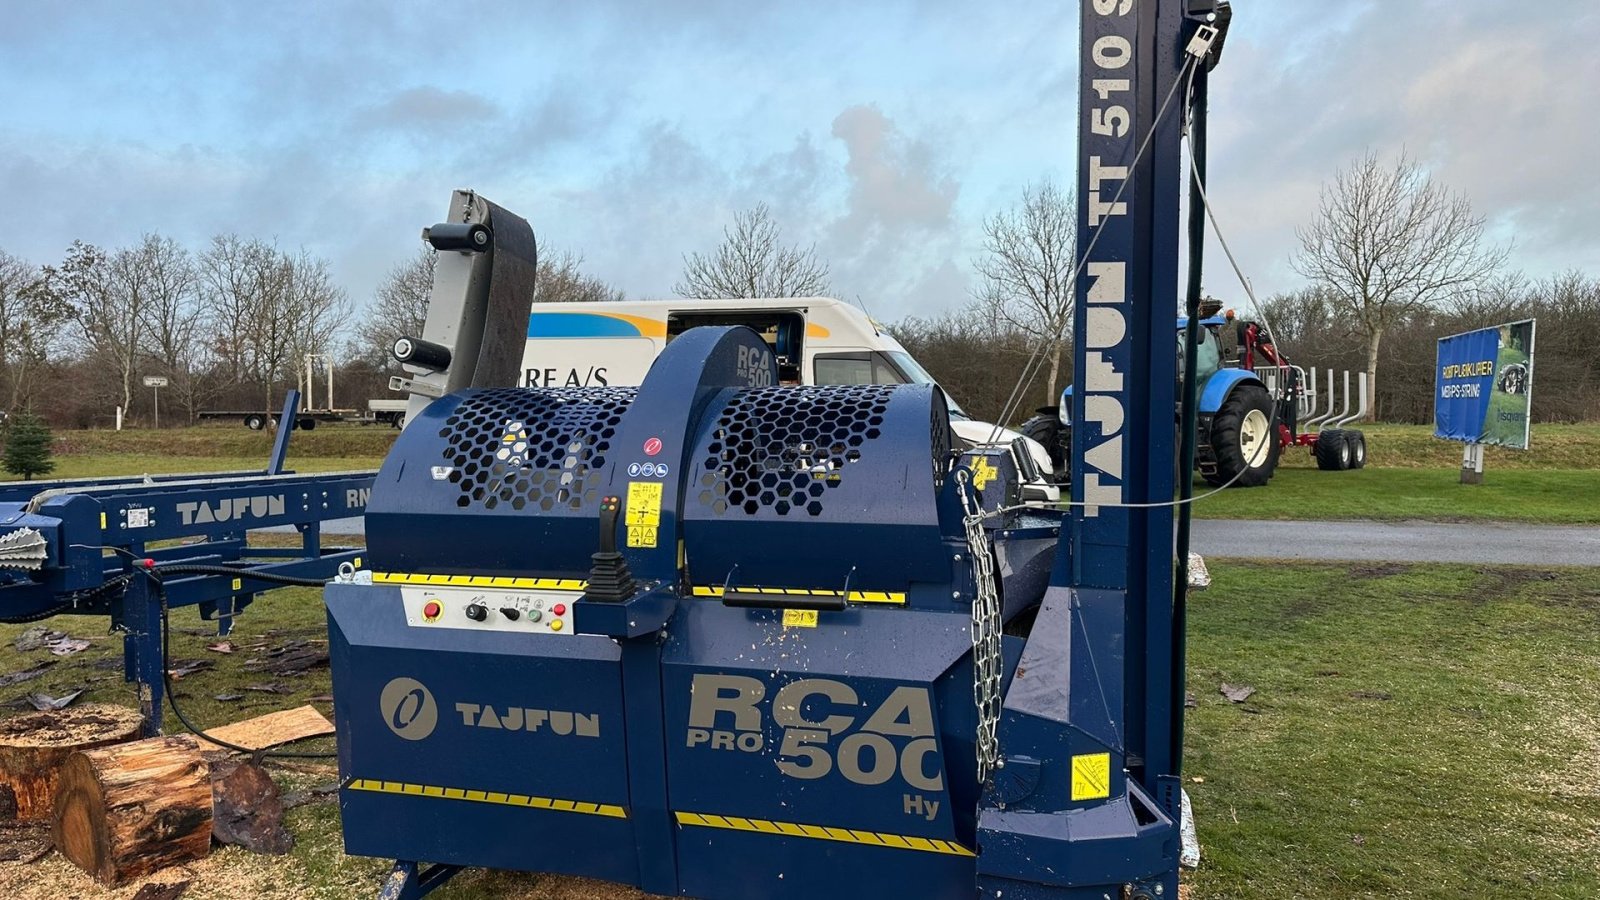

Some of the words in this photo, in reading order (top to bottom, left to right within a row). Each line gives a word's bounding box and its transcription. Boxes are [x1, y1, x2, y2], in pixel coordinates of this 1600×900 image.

[1091, 35, 1132, 138] 510
[1088, 155, 1128, 227] TT
[738, 344, 769, 370] RCA
[565, 366, 608, 388] A/S
[748, 367, 772, 388] 500
[1084, 261, 1127, 518] TAJFUN
[176, 495, 285, 525] TAJFUN
[455, 702, 600, 737] TAJFUN
[688, 673, 936, 737] RCA
[686, 728, 765, 752] PRO
[775, 728, 944, 791] 500
[903, 794, 940, 821] Hy
